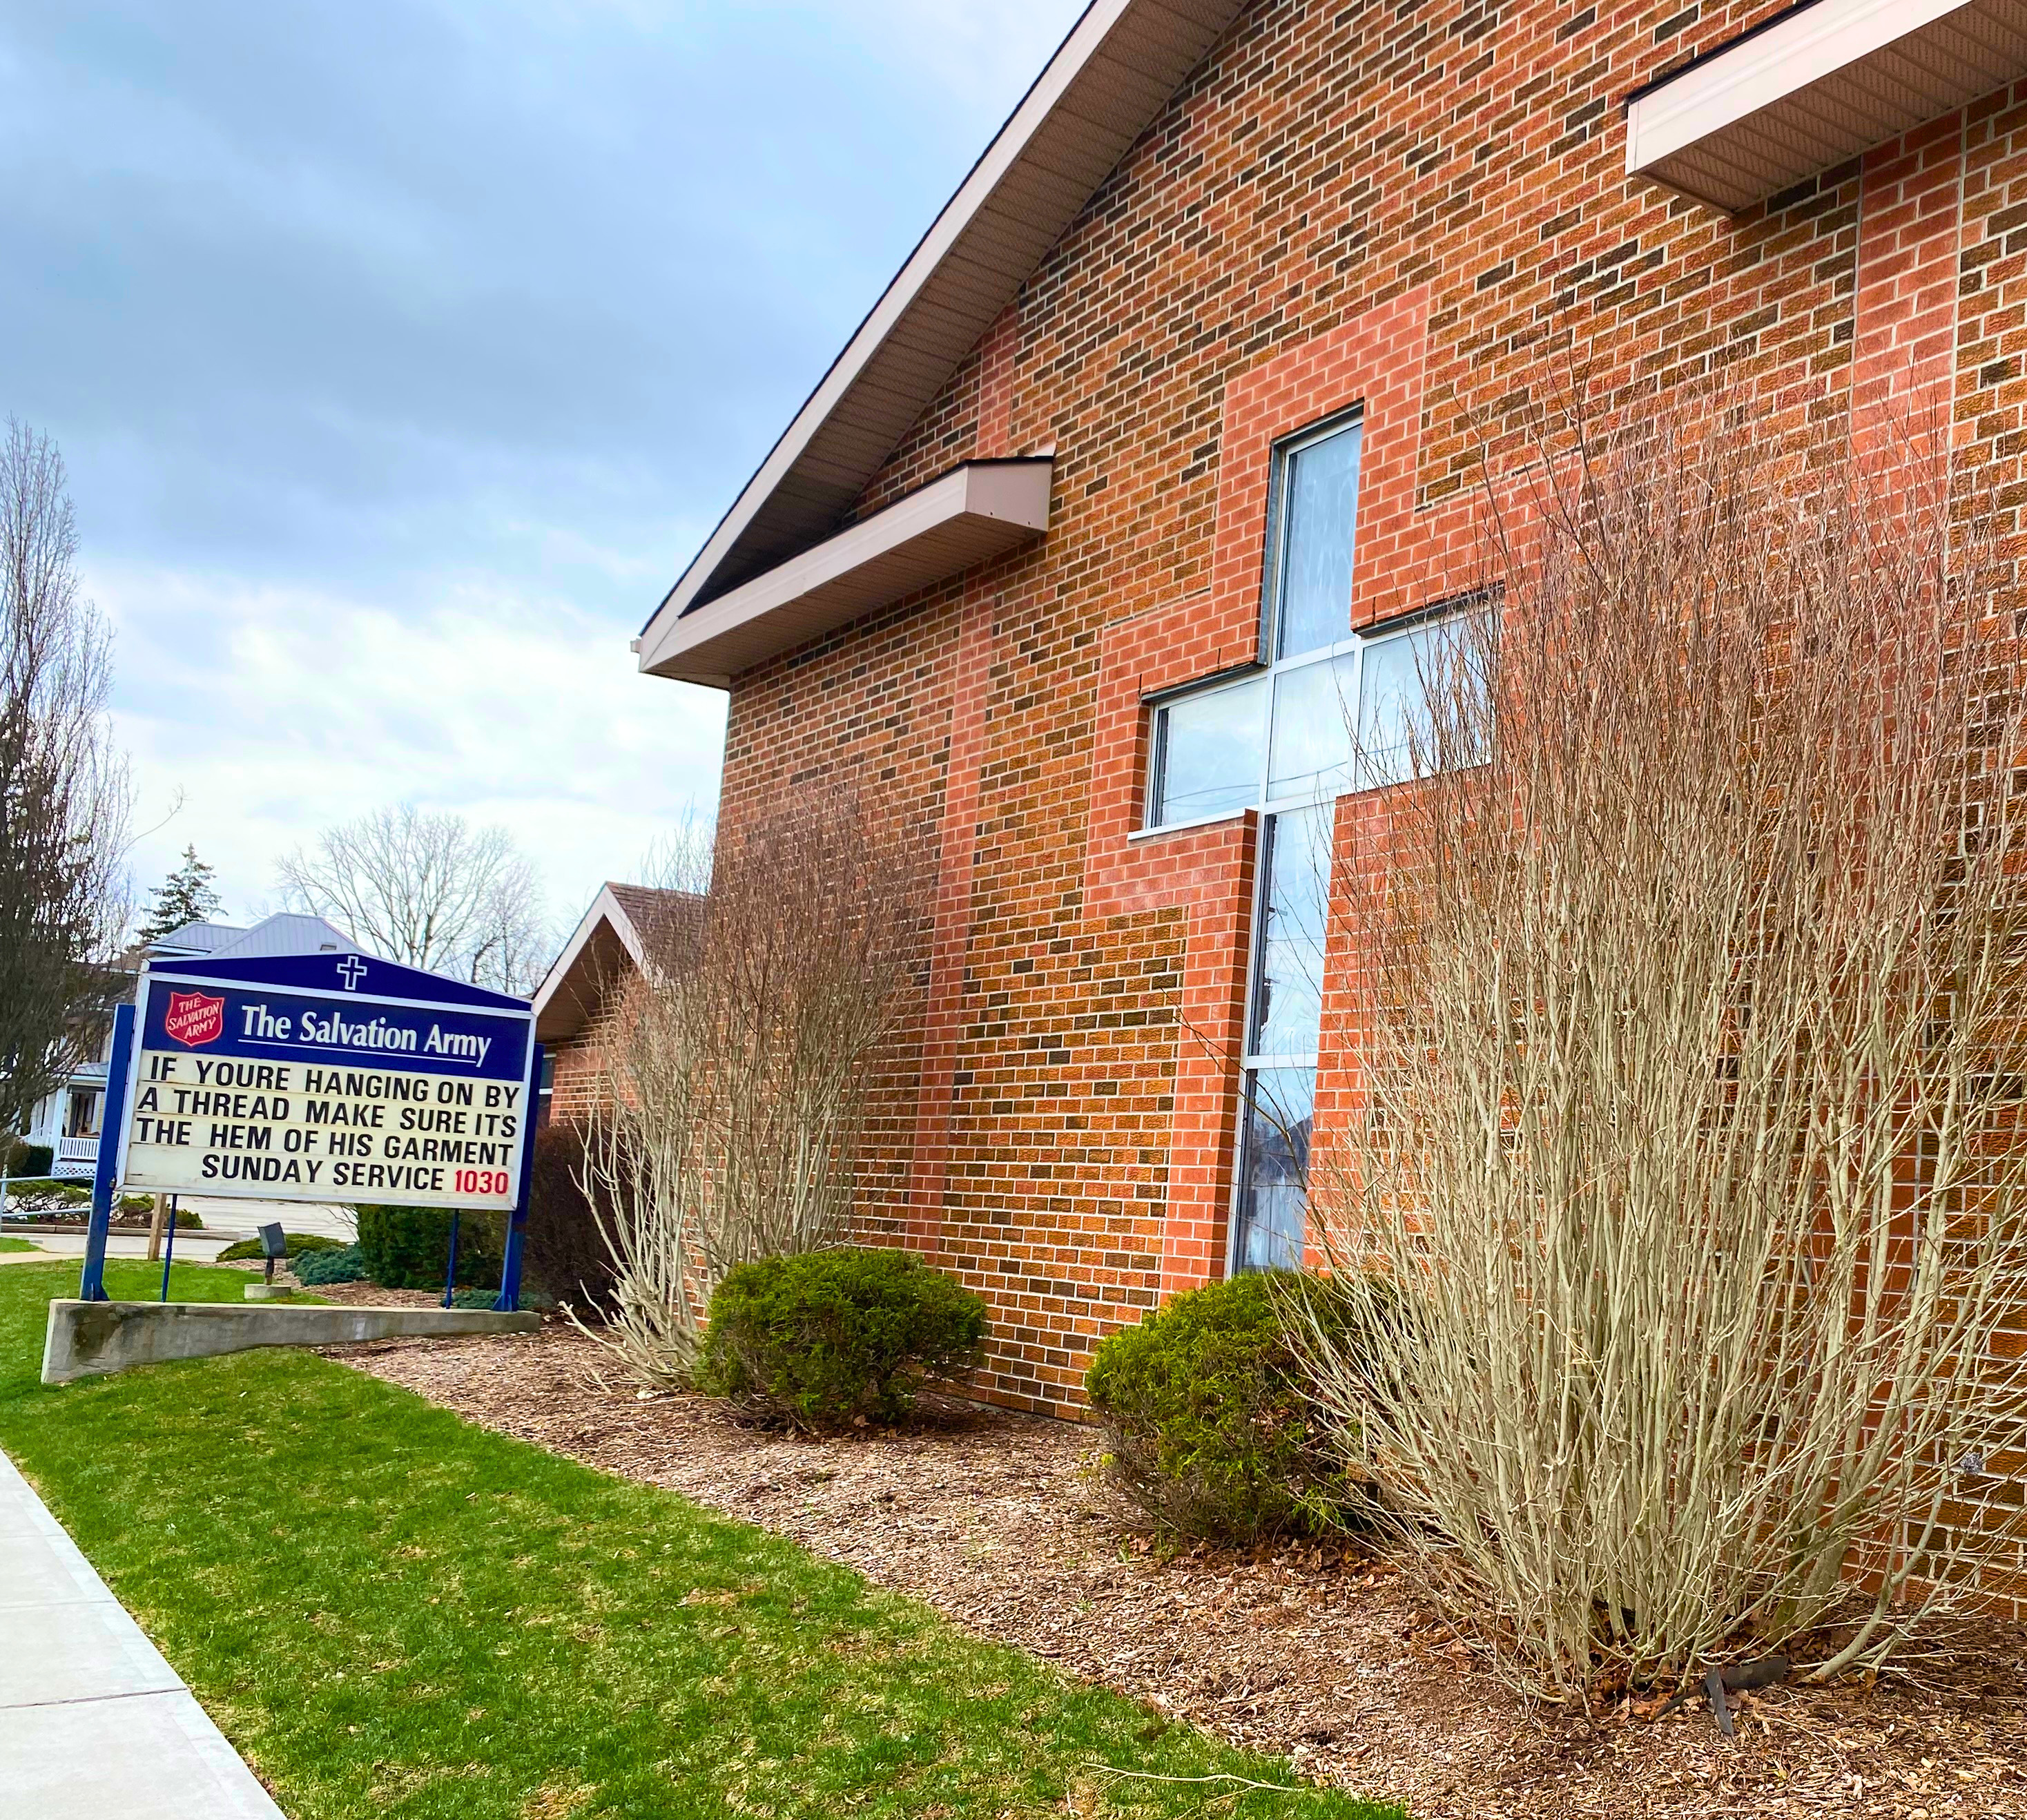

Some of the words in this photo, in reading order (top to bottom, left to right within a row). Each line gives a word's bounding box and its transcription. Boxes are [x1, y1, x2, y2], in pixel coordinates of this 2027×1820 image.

[168, 1002, 220, 1031] SALVATION
[179, 997, 202, 1013] THE
[184, 1016, 216, 1039] ARMY
[242, 1005, 291, 1039] The
[300, 1011, 416, 1051] Salvation
[423, 1024, 492, 1067] Army
[151, 1056, 177, 1081] IF
[195, 1060, 291, 1090] YOURE
[305, 1069, 429, 1102] HANGING
[437, 1081, 473, 1105] ON
[485, 1085, 520, 1108] BY
[137, 1087, 157, 1112] A
[174, 1090, 289, 1121] THREAD
[306, 1100, 385, 1127] MAKE
[400, 1107, 467, 1134] SURE
[137, 1117, 192, 1145] THE
[210, 1123, 271, 1150] HEM
[284, 1129, 318, 1153] OF
[329, 1132, 374, 1157] HIS
[384, 1135, 514, 1166] GARMENT
[202, 1154, 324, 1183] SUNDAY
[333, 1162, 445, 1191] SERVICE
[455, 1169, 510, 1194] 1030
